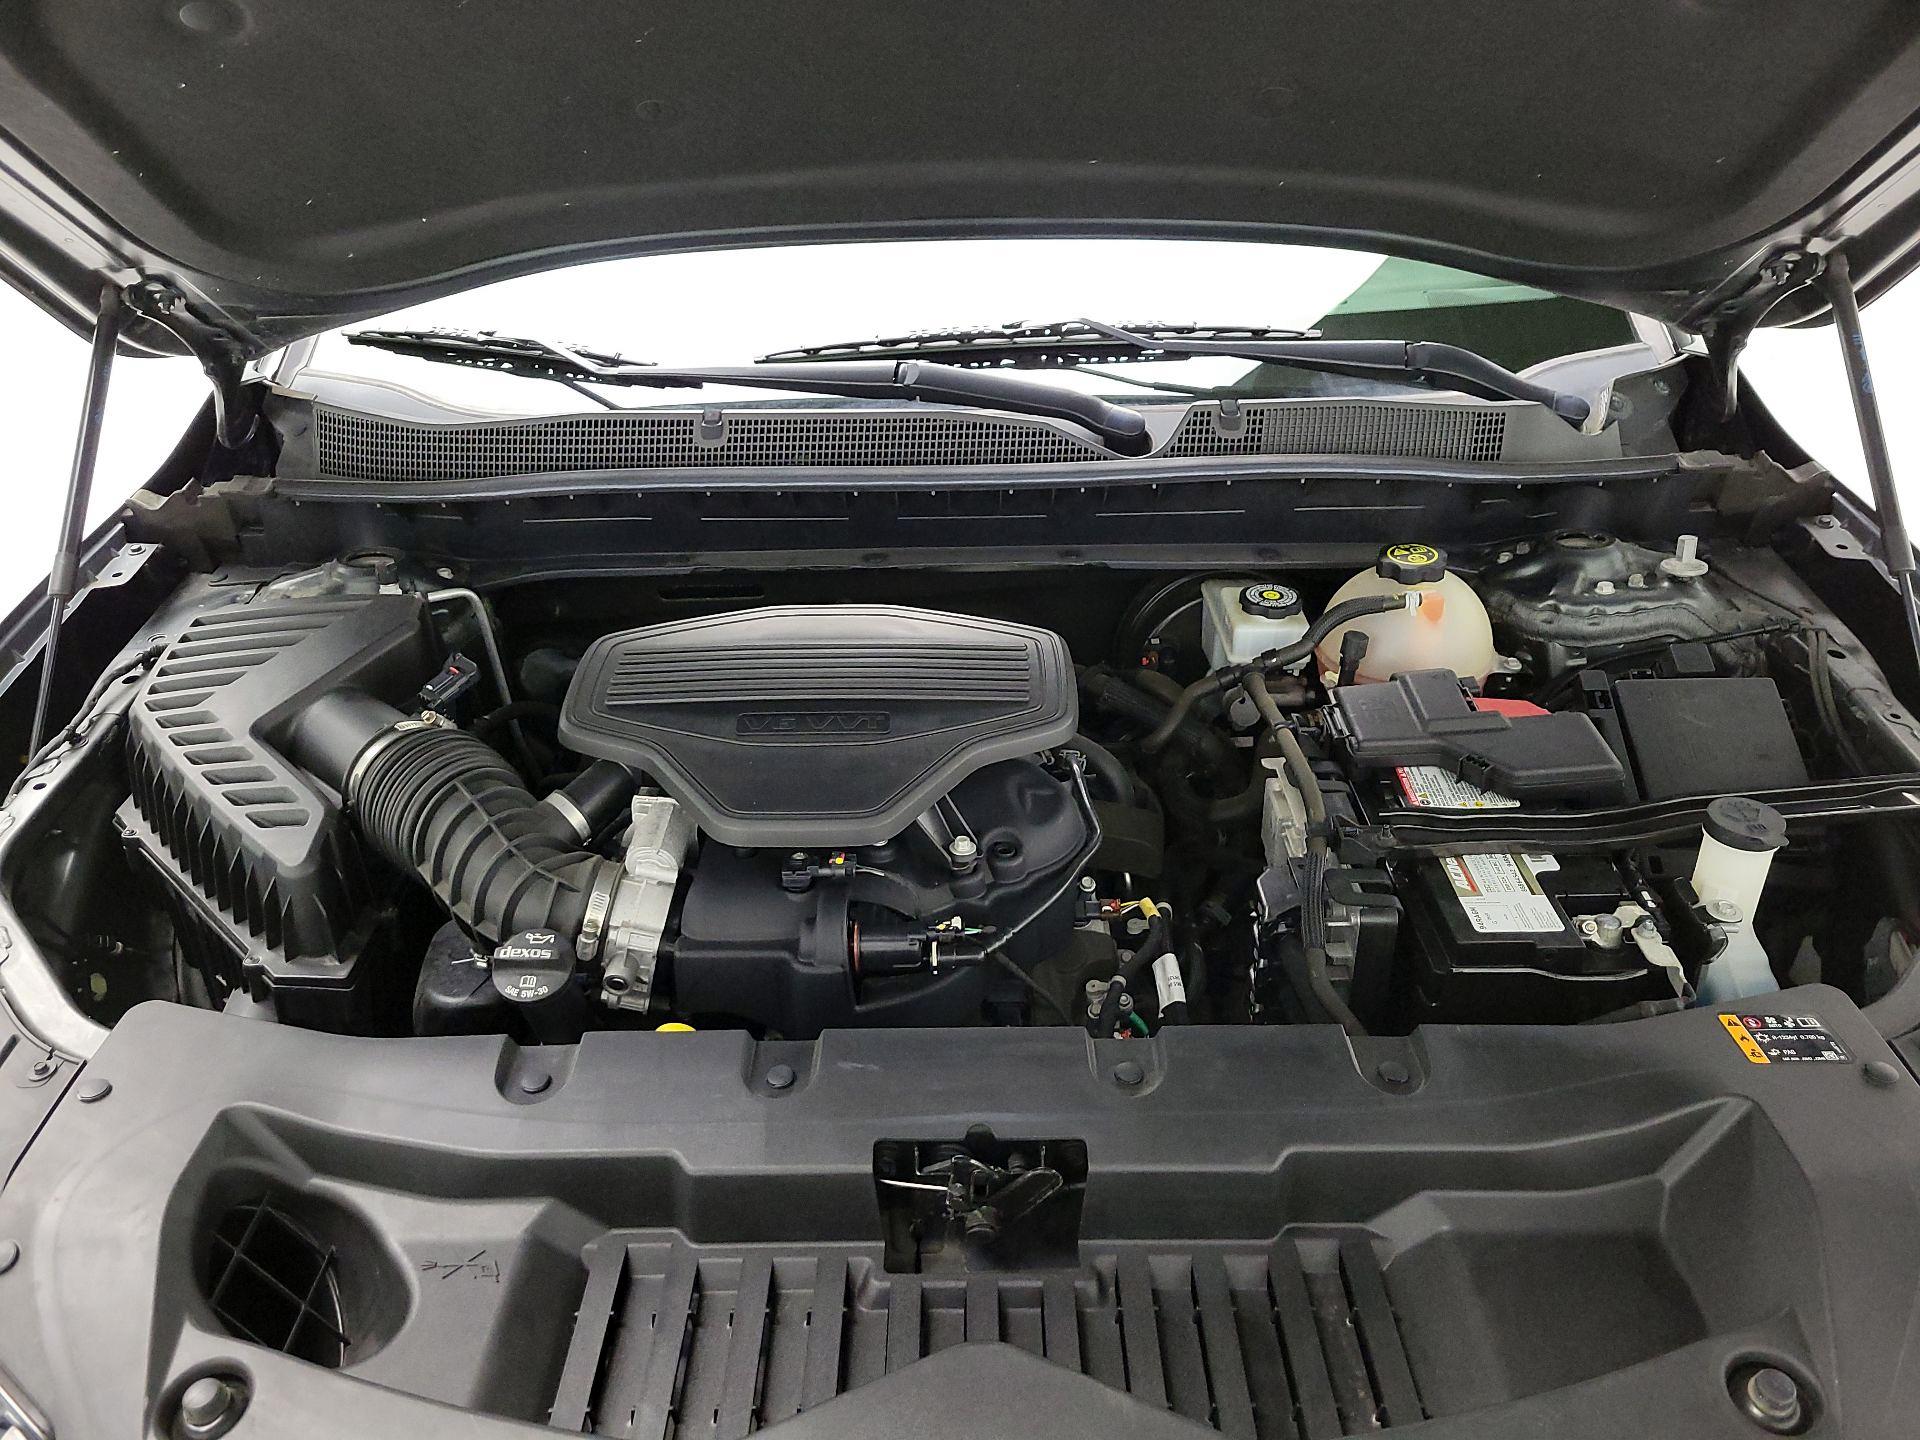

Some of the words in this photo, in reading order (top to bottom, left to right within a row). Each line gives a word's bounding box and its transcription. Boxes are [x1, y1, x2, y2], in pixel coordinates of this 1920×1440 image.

[806, 715, 885, 730] VVT
[1445, 857, 1472, 891] ACDe
[500, 946, 552, 959] dexos
[505, 985, 520, 997] SAE
[520, 985, 549, 998] 5W-30
